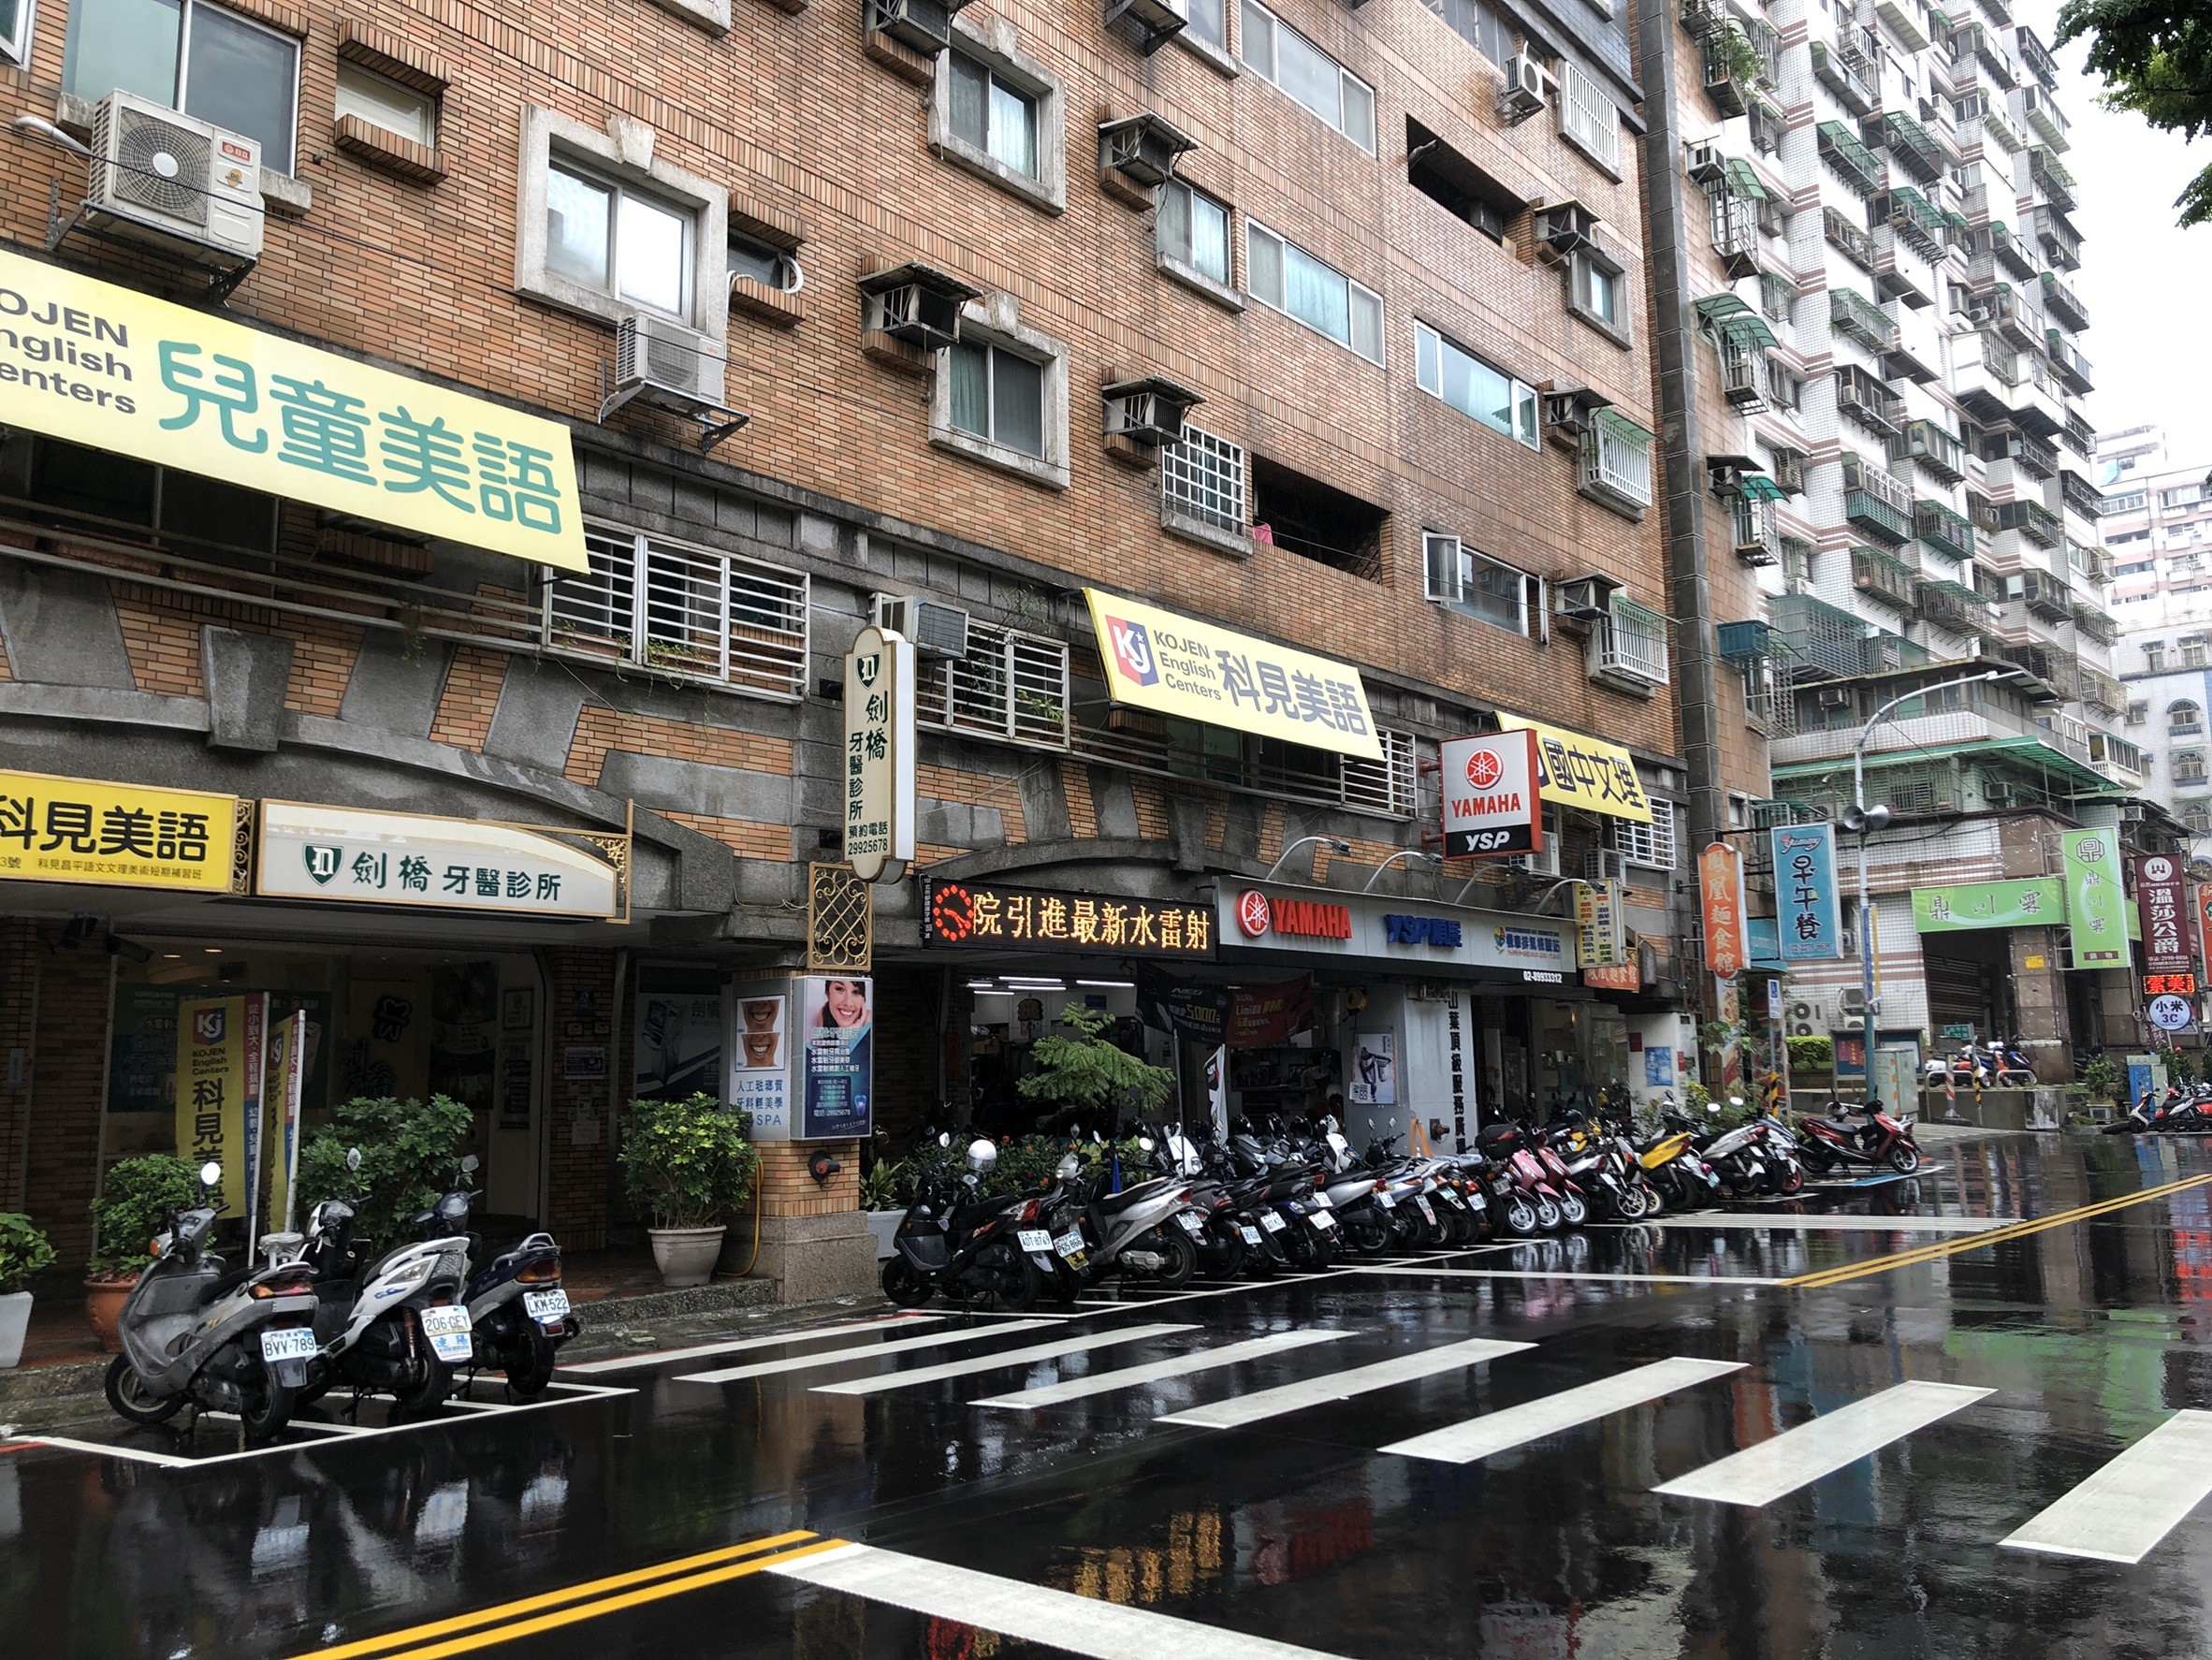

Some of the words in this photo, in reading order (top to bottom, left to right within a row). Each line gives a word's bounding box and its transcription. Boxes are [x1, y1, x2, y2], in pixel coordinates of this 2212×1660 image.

[157, 339, 561, 534] 兒童美語
[1153, 630, 1211, 660] KOJEN
[1158, 651, 1216, 680] English
[1165, 674, 1222, 701] Centers
[1215, 649, 1368, 736] 科見美語
[866, 691, 888, 762] 劍橋
[849, 732, 864, 821] 牙醫診所
[1542, 736, 1644, 809] 國中文理
[1451, 793, 1521, 819] YAMAHA
[0, 795, 211, 862] 科見美語
[848, 821, 888, 839] 預約電話
[1465, 830, 1510, 852] YSP
[848, 838, 888, 855] 29925678
[351, 851, 562, 901] 劍橋牙醫診所
[1706, 849, 1737, 973] 鳳凰麵食館
[1792, 854, 1822, 940] 早午餐
[972, 891, 1211, 951] 院引進最新水雷射
[1269, 897, 1353, 939] YAMAHA
[2148, 888, 2179, 954] 溫莎公爵
[2155, 1000, 2184, 1012] 小米
[2162, 1013, 2178, 1023] 3C
[192, 1047, 226, 1058] KOJEN
[193, 1057, 227, 1067] English
[192, 1067, 229, 1076] Centers
[756, 1114, 782, 1126] SPA
